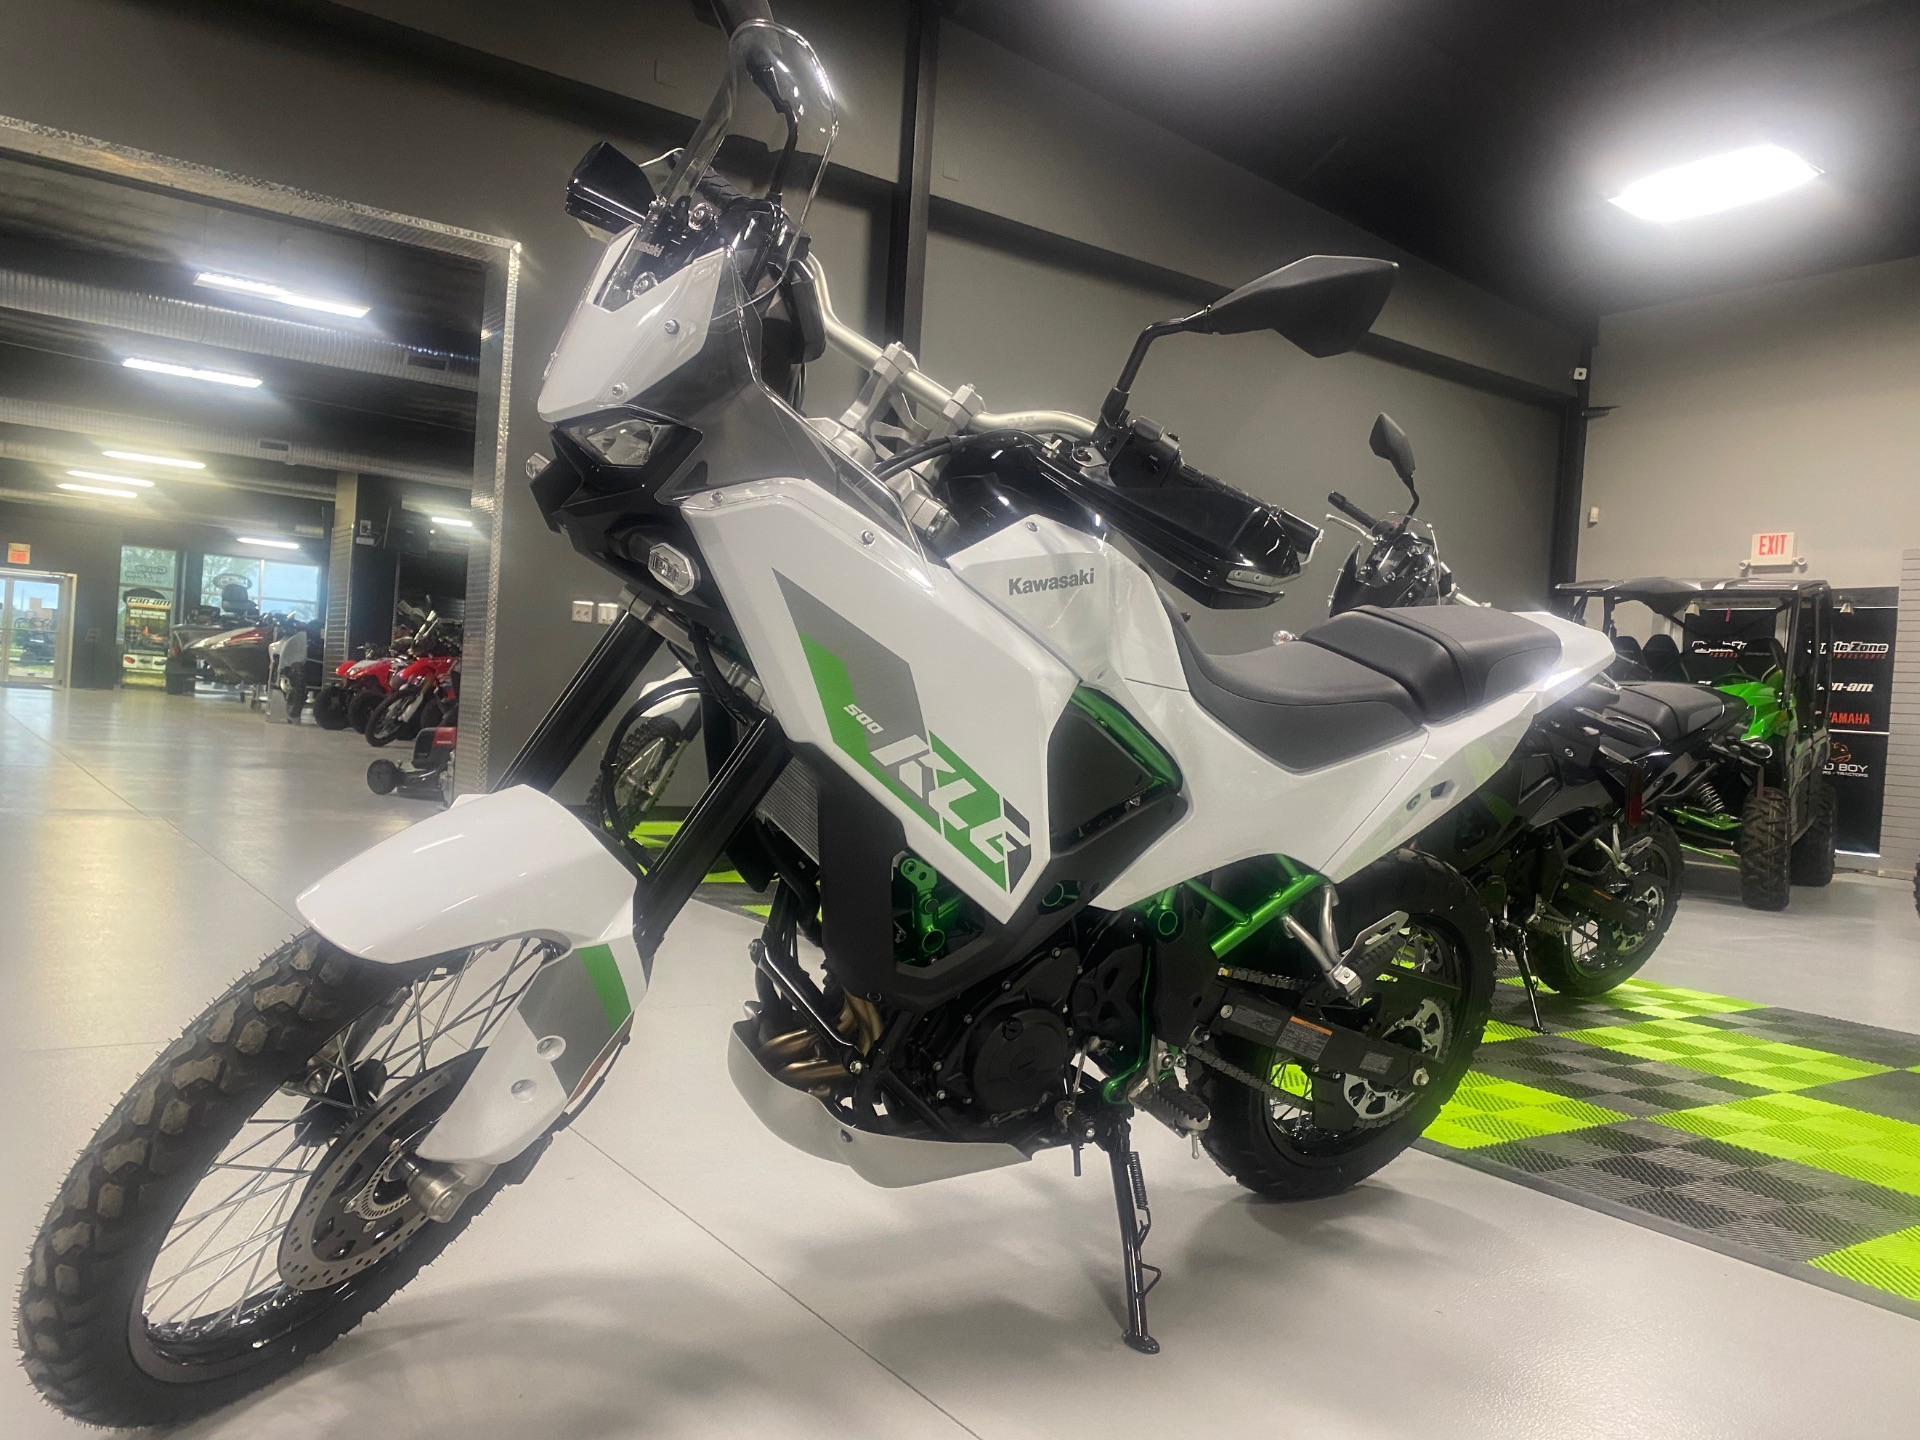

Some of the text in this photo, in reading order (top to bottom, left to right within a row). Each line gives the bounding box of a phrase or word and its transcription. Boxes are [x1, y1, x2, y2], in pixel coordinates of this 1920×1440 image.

[1758, 534, 1788, 556] EXIT
[1008, 567, 1095, 596] Kawasaki
[1849, 641, 1889, 653] Zone
[842, 702, 885, 735] 500
[1838, 763, 1869, 773] BOY
[869, 733, 1031, 865] KLE
